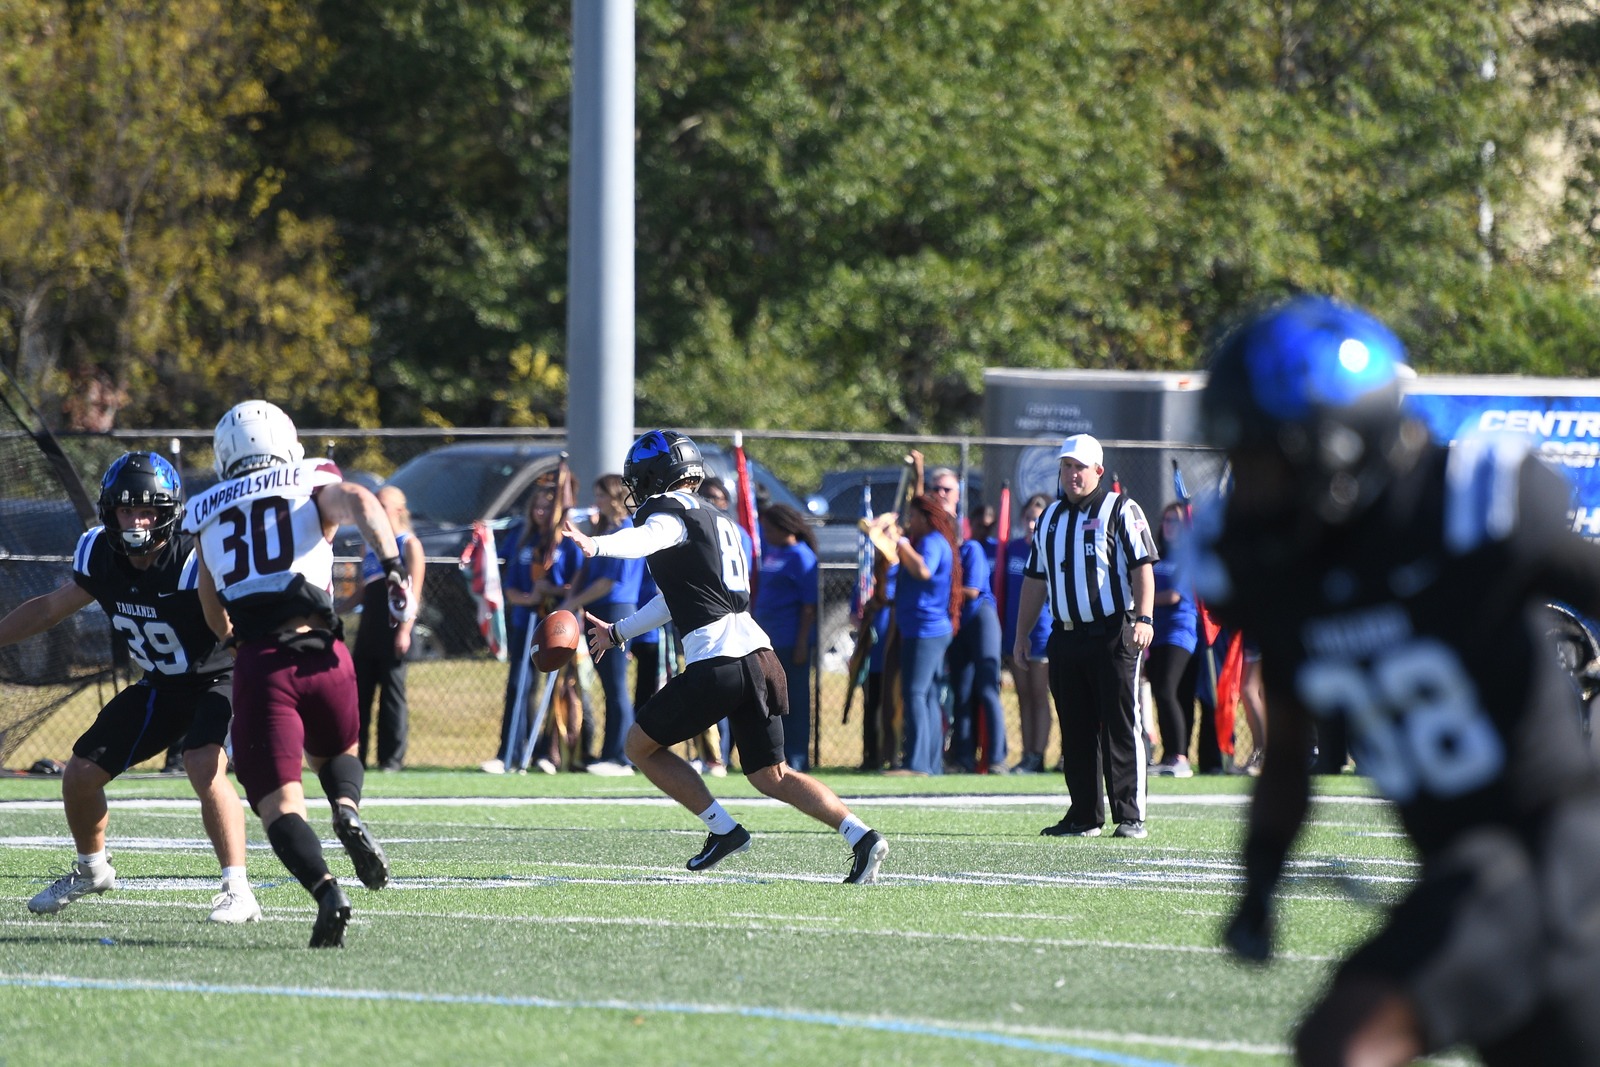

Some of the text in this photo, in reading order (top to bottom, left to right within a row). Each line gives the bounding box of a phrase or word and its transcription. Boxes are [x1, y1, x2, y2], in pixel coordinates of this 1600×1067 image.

[194, 467, 300, 525] CAMPBELLSVILLE
[218, 495, 295, 586] 30
[716, 515, 750, 592] 8
[1085, 543, 1095, 556] R
[116, 601, 157, 619] FAULKNER
[112, 615, 190, 675] 39
